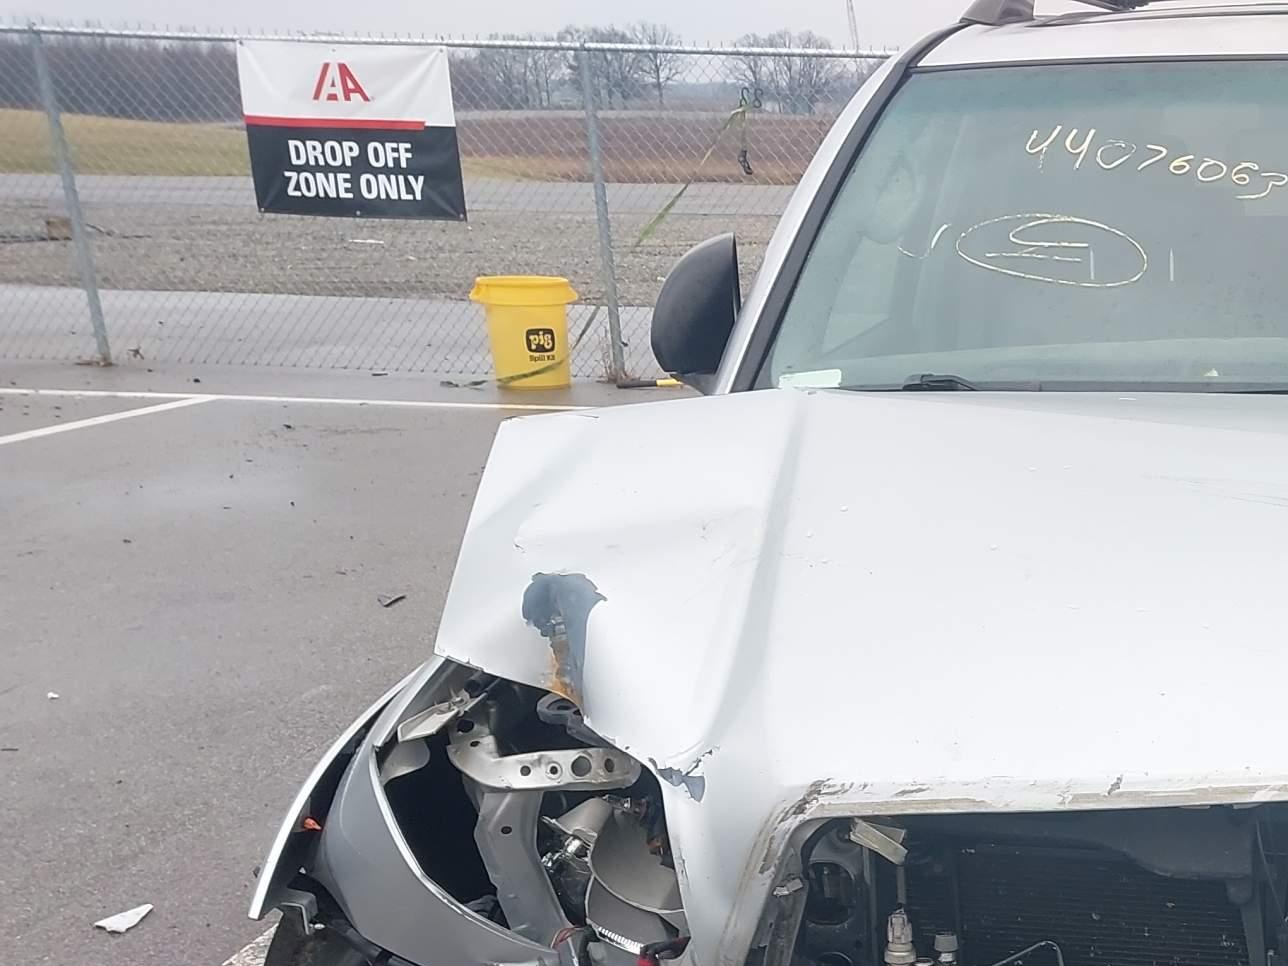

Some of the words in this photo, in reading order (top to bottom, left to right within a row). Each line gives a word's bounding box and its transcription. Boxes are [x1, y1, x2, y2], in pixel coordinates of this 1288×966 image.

[287, 140, 360, 167] DROP
[367, 141, 412, 168] OFF
[1025, 125, 1288, 199] 44076063
[284, 171, 354, 199] ZONE
[360, 173, 425, 200] ONLY
